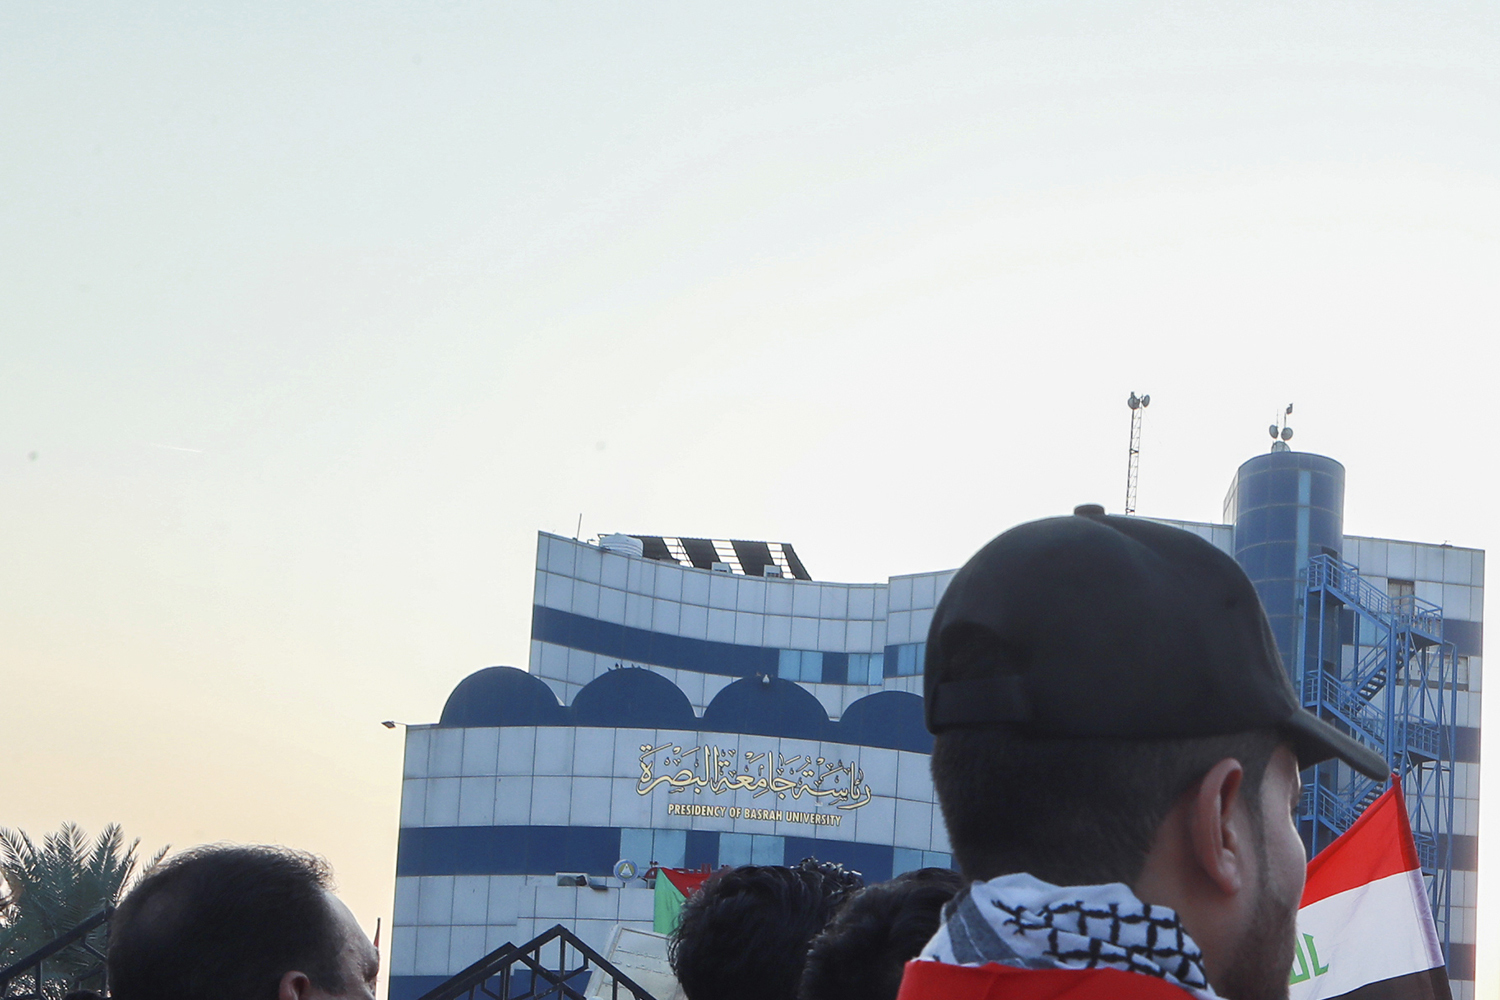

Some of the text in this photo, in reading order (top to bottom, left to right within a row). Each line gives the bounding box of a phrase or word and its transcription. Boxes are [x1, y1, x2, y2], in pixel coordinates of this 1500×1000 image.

[668, 803, 842, 827] PRESIDENCY OF BASRAH UNIVERSITY
